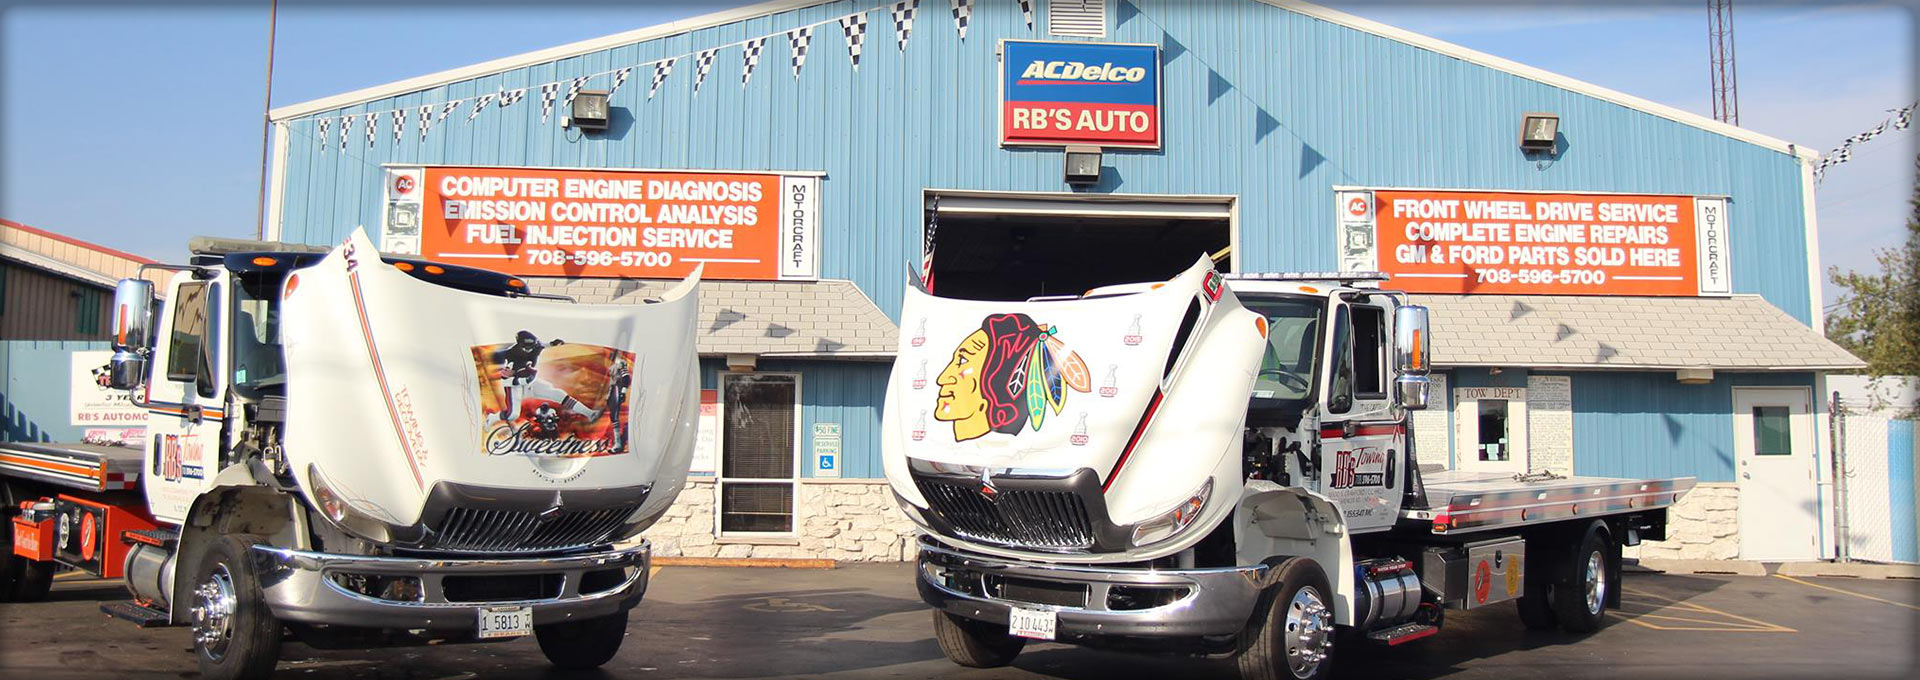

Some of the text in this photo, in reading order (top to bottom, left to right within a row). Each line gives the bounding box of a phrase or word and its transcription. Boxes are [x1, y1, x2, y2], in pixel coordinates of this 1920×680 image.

[1021, 60, 1146, 82] ACDelco
[1013, 107, 1149, 133] RB'S AUTO
[397, 178, 413, 189] AC
[441, 176, 763, 202] COMPUTER ENGINE DIAGNOSIS
[444, 200, 758, 226] EMISSION CONTROL ANALYSIS
[1351, 202, 1365, 212] AC
[1393, 199, 1678, 223] FRONT WHEEL DRIVE SERVICE
[467, 224, 734, 249] FUEL INJECTION SERVICE
[792, 184, 806, 268] MOTORCRAFT
[1405, 221, 1669, 245] COMPLETE ENGINE REPAIRS
[1395, 244, 1680, 267] GM & FORD PARTS SOLD HERE
[1705, 206, 1718, 285] MOTORCRAFT
[527, 250, 673, 267] 708-596-5700
[1475, 268, 1606, 285] 708-596-5700
[1464, 388, 1522, 398] TOW DEPT
[486, 421, 611, 457] Sweetness
[482, 616, 488, 630] 1
[494, 614, 520, 630] 5813
